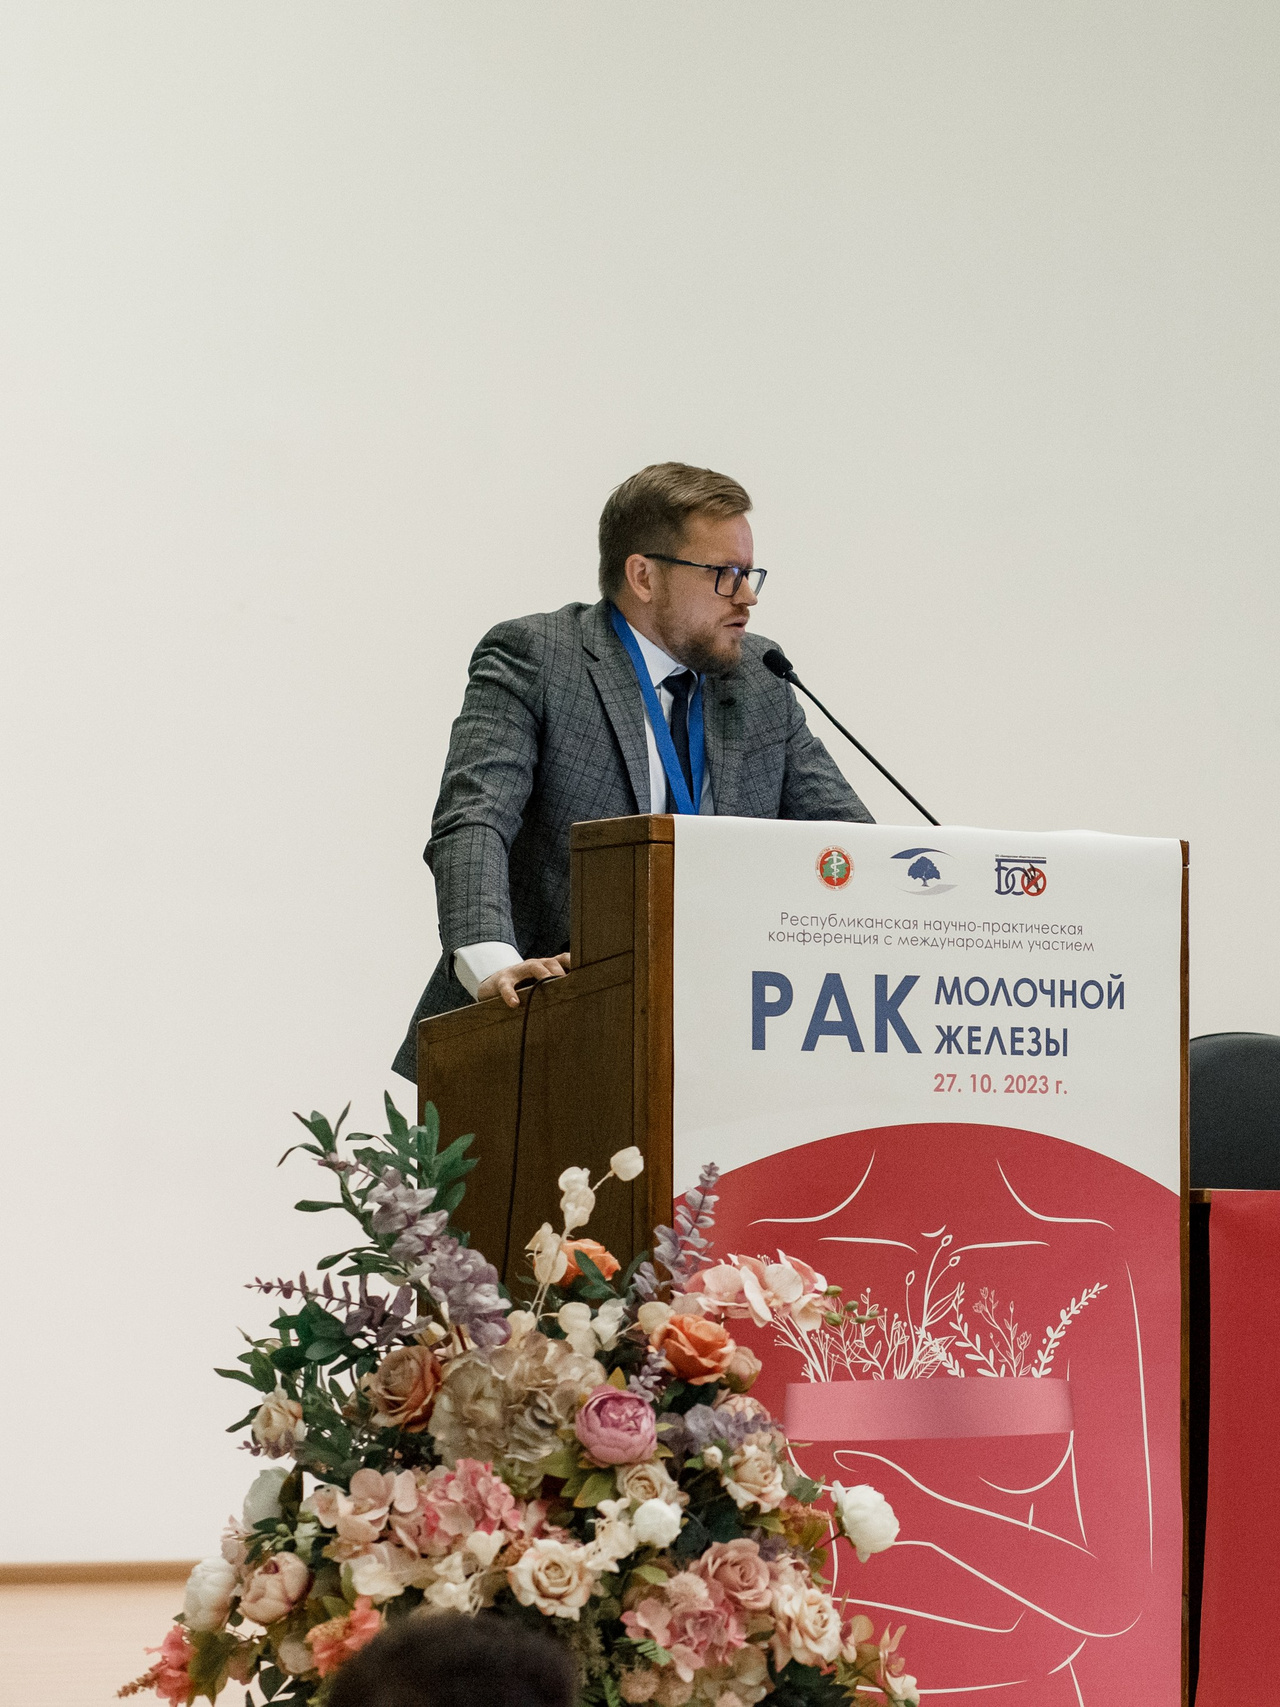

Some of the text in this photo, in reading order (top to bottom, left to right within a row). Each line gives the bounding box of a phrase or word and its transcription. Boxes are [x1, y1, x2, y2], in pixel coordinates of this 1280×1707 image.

[780, 911, 1083, 936] Республиканская научно-практическая
[768, 929, 1095, 952] конференция с международным участием
[934, 973, 1125, 1010] МОЛОЧНОЙ
[751, 970, 923, 1054] РАК
[934, 1025, 1068, 1057] ЖЕЛЕЗЫ
[933, 1072, 1068, 1095] 27. 10. 2023 г.
